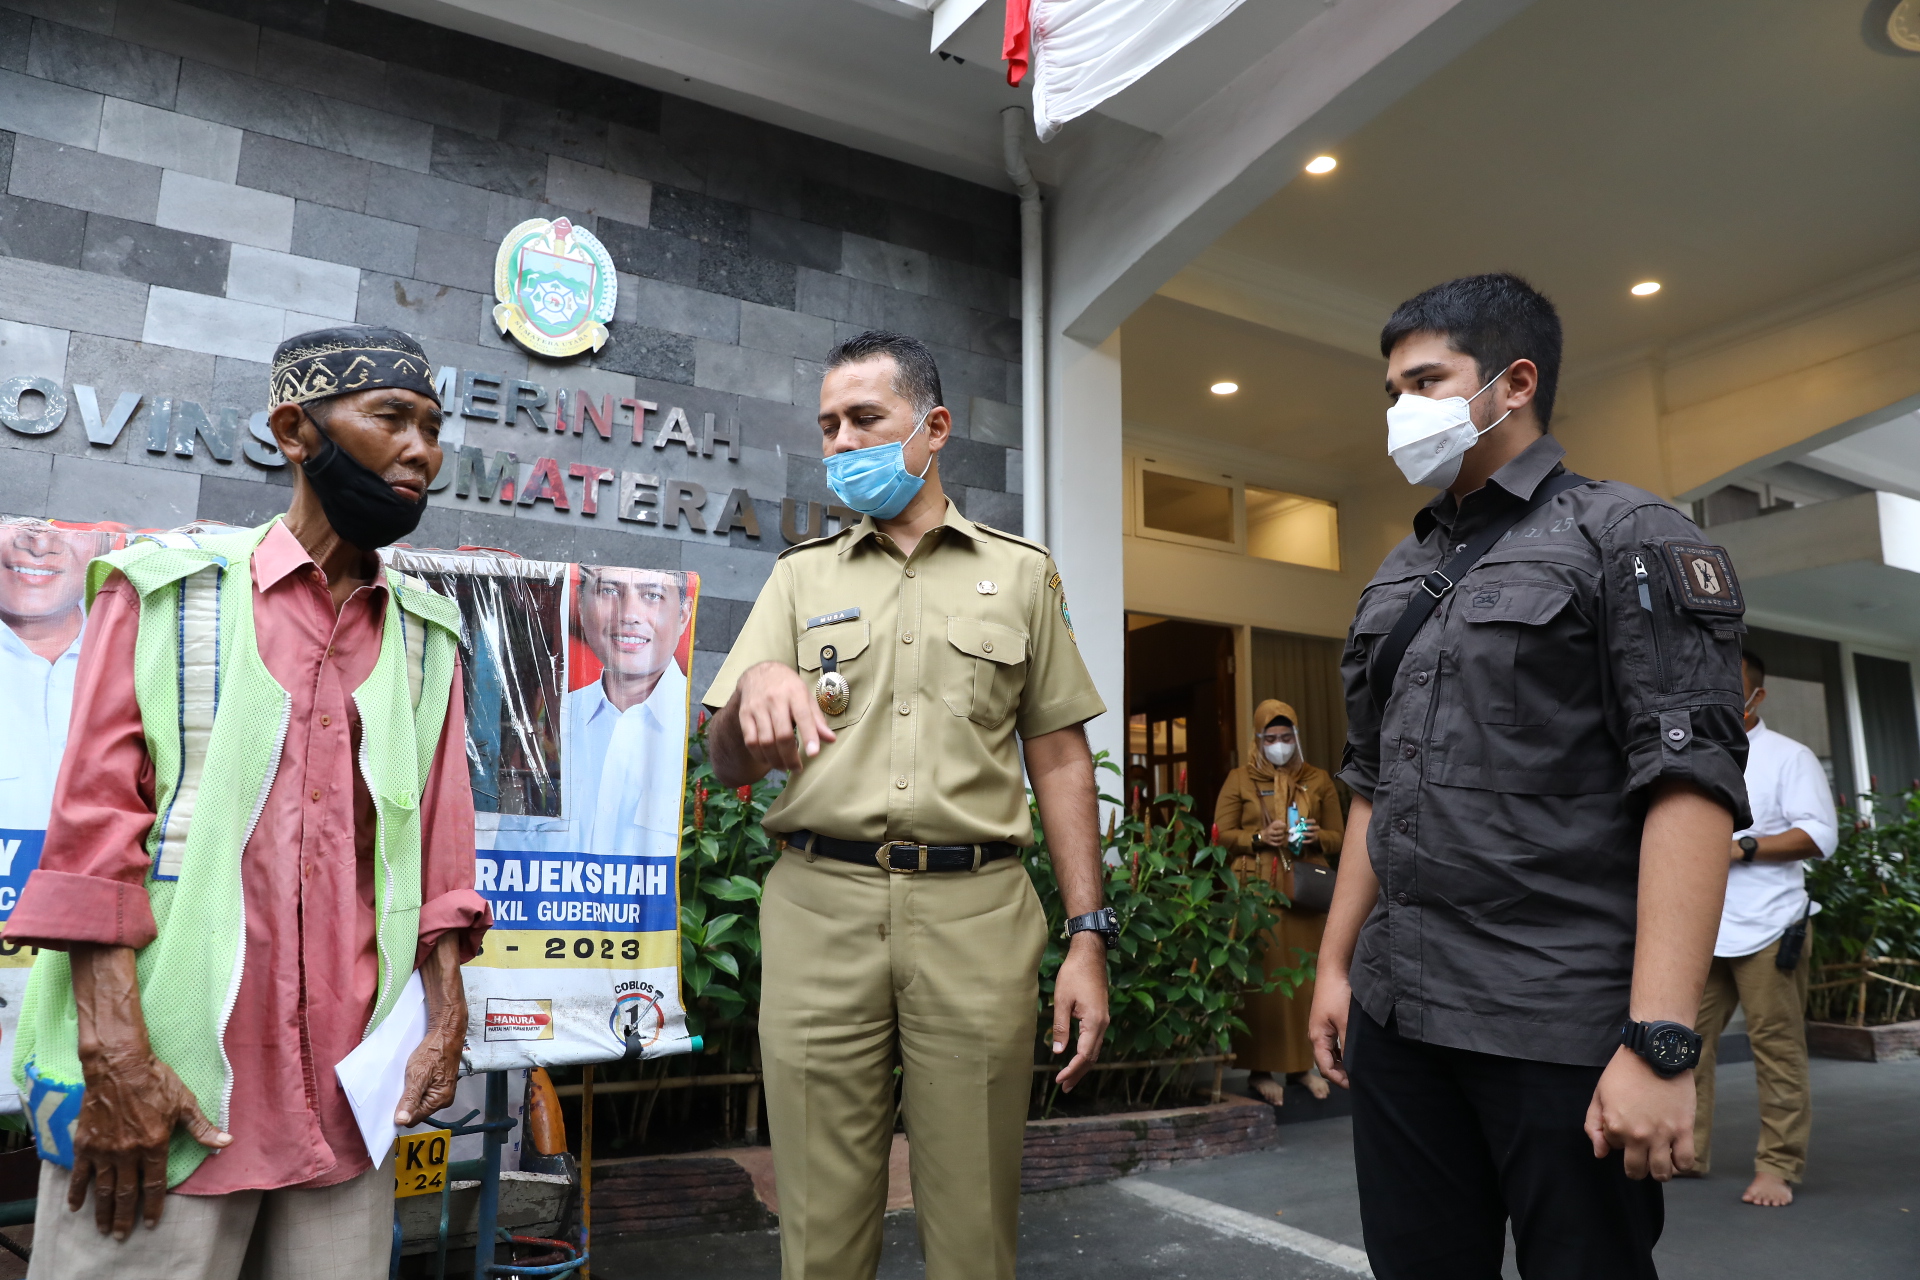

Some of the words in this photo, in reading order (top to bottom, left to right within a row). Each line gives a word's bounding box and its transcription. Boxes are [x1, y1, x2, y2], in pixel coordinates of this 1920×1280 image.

[820, 612, 845, 623] MUSA
[474, 859, 667, 896] RAJEKSHAH
[537, 901, 640, 924] GUBERNUR
[545, 937, 640, 960] 2023
[614, 980, 654, 994] COBLOS
[493, 1015, 536, 1025] HANURA
[406, 1137, 446, 1170] KQ
